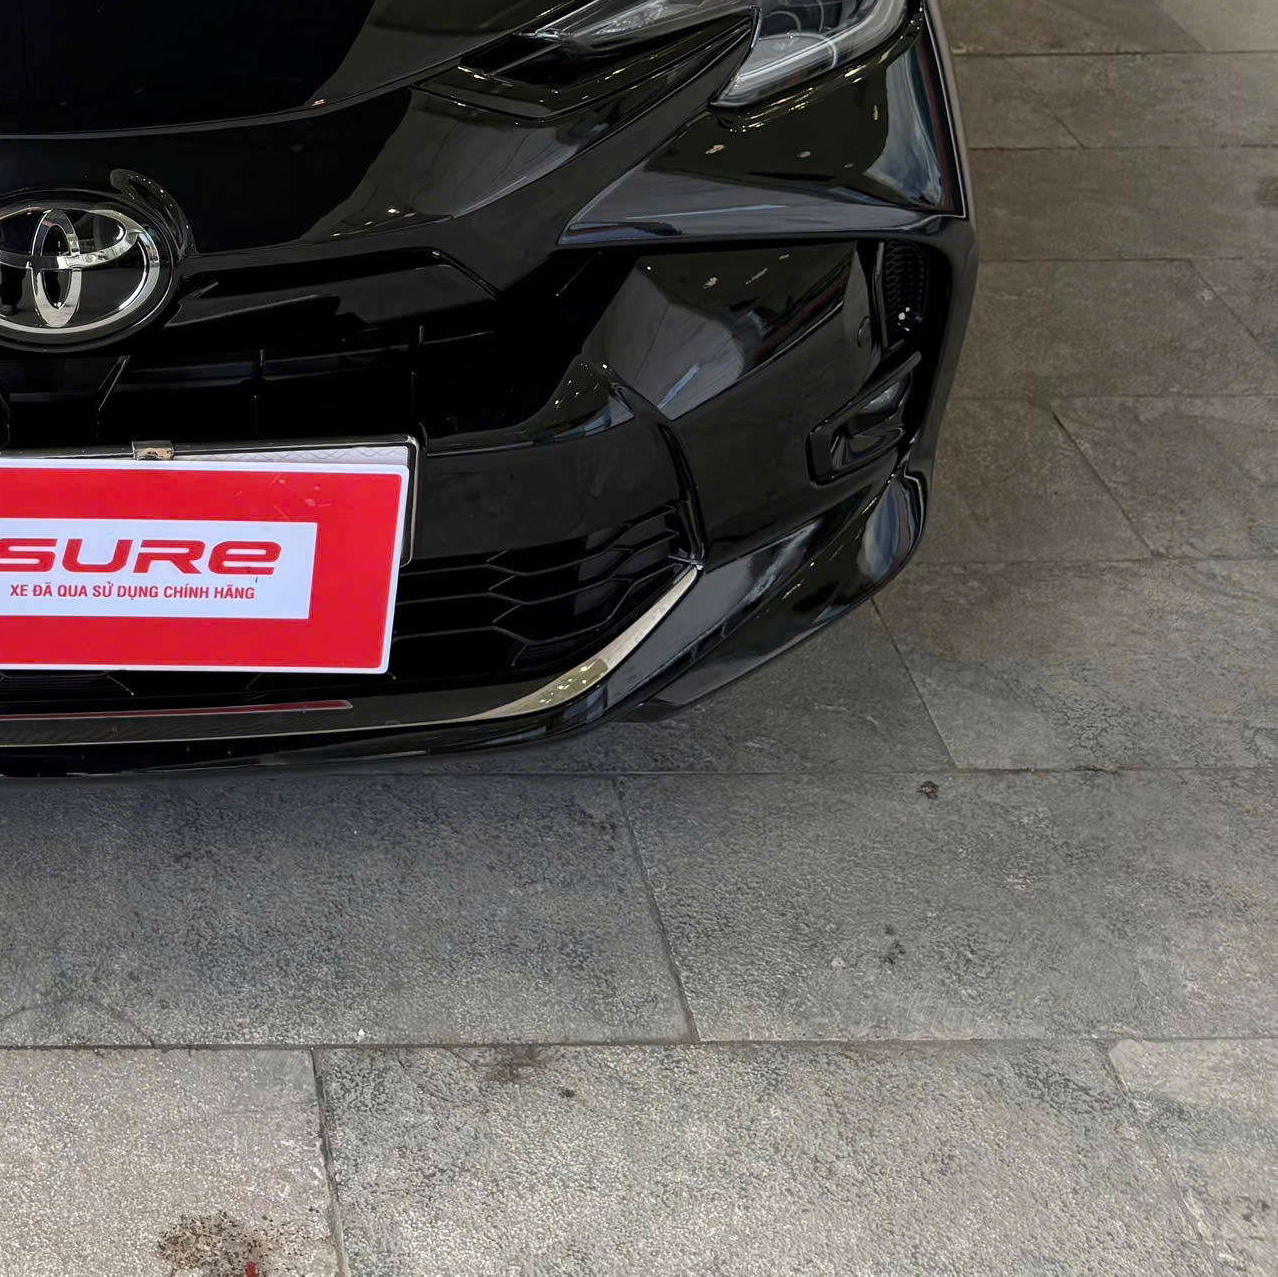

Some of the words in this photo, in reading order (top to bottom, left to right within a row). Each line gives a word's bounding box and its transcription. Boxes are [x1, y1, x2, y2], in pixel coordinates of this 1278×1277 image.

[9, 583, 28, 597] XE
[32, 581, 53, 597] ĐÃ
[57, 583, 88, 598] QUA
[92, 580, 114, 598] SỬ
[116, 584, 159, 601] DỤNG
[163, 582, 210, 599] CHÍNH
[213, 584, 256, 600] HÃNG
